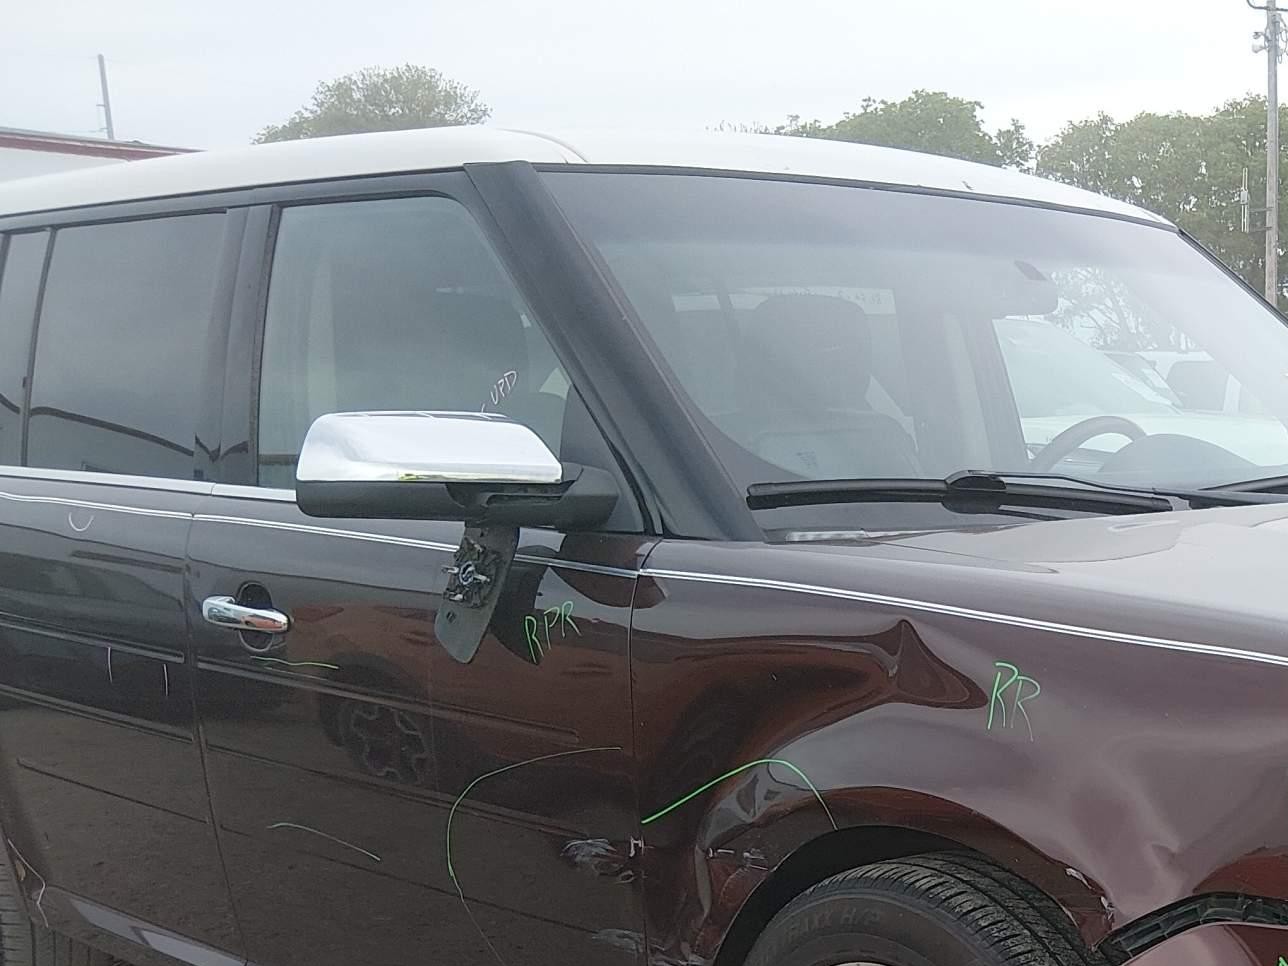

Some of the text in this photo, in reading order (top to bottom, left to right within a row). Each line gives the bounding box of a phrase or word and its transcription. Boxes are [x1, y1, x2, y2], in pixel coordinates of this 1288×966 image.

[490, 370, 517, 405] UPD
[525, 601, 582, 664] RPR
[988, 662, 1041, 742] RR
